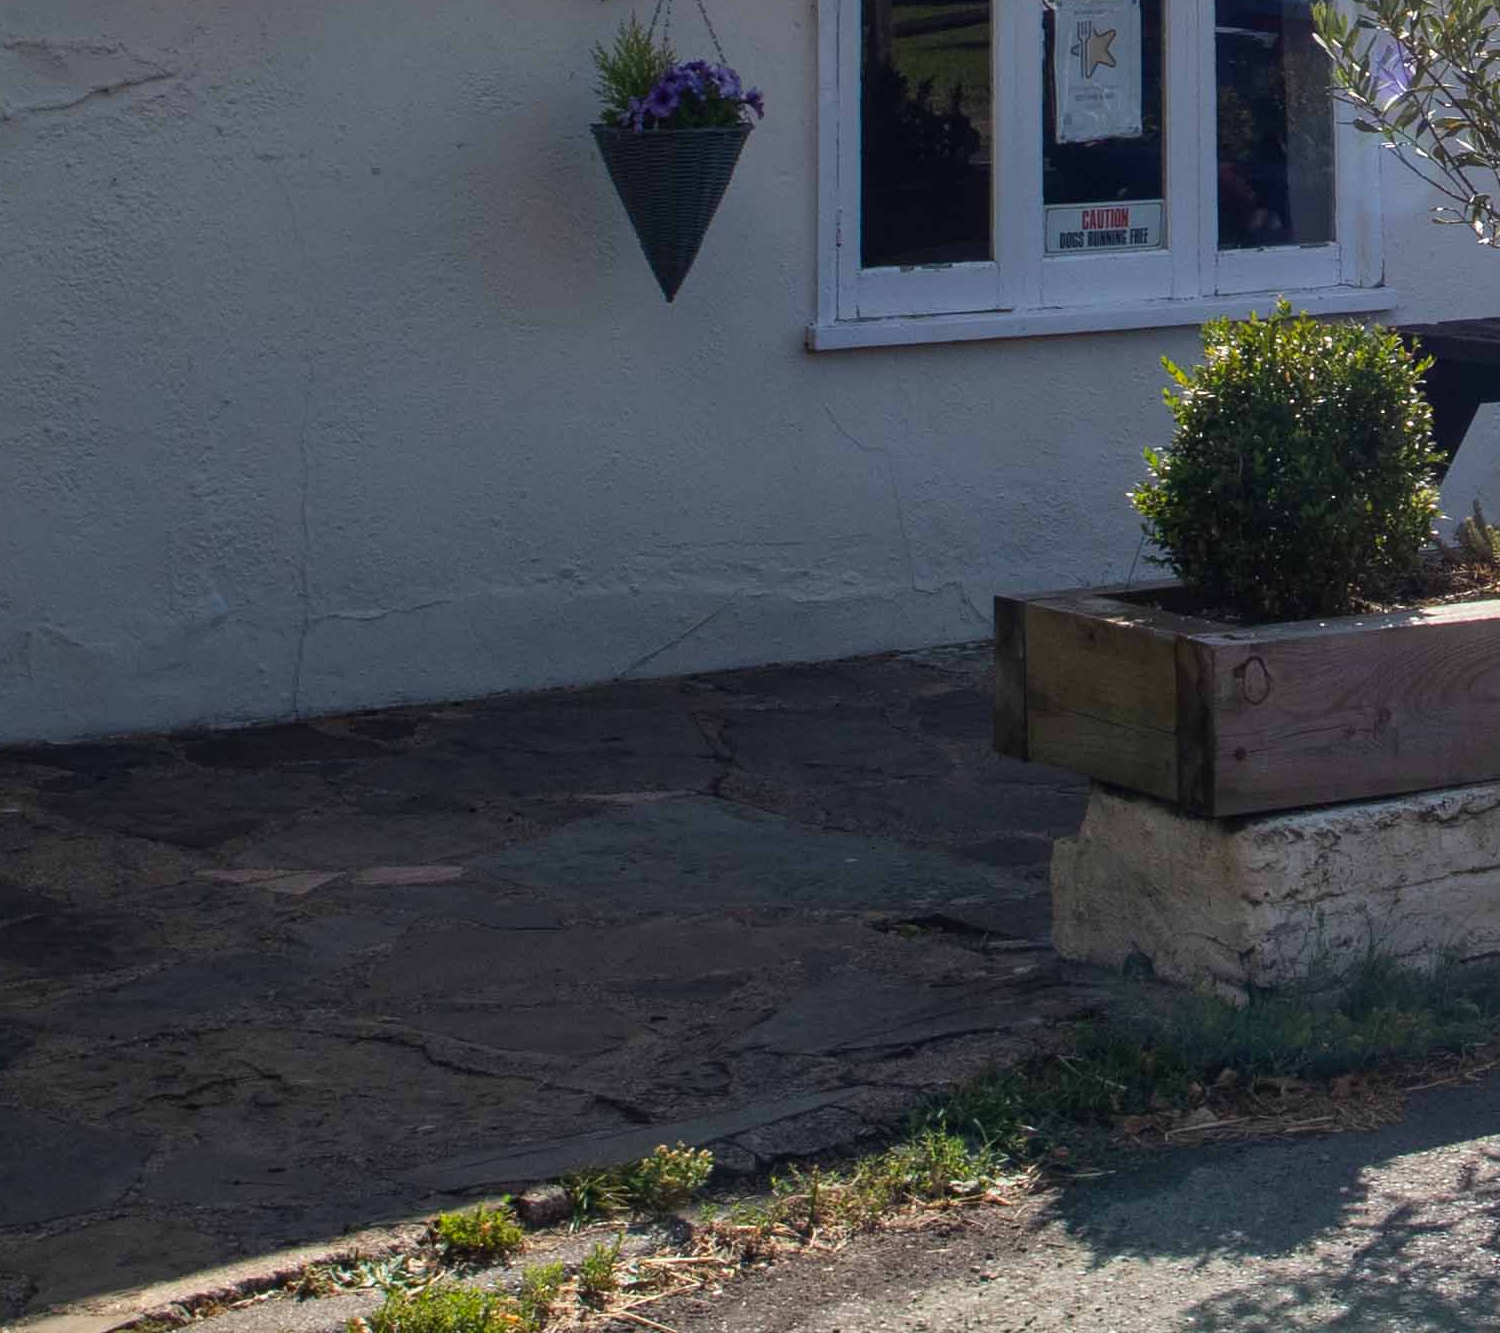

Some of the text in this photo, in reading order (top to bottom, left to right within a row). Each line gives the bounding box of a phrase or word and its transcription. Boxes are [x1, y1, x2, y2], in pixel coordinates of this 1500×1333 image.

[1082, 208, 1130, 230] CAUTION
[1060, 227, 1149, 249] DOGS RUNNING FREE
